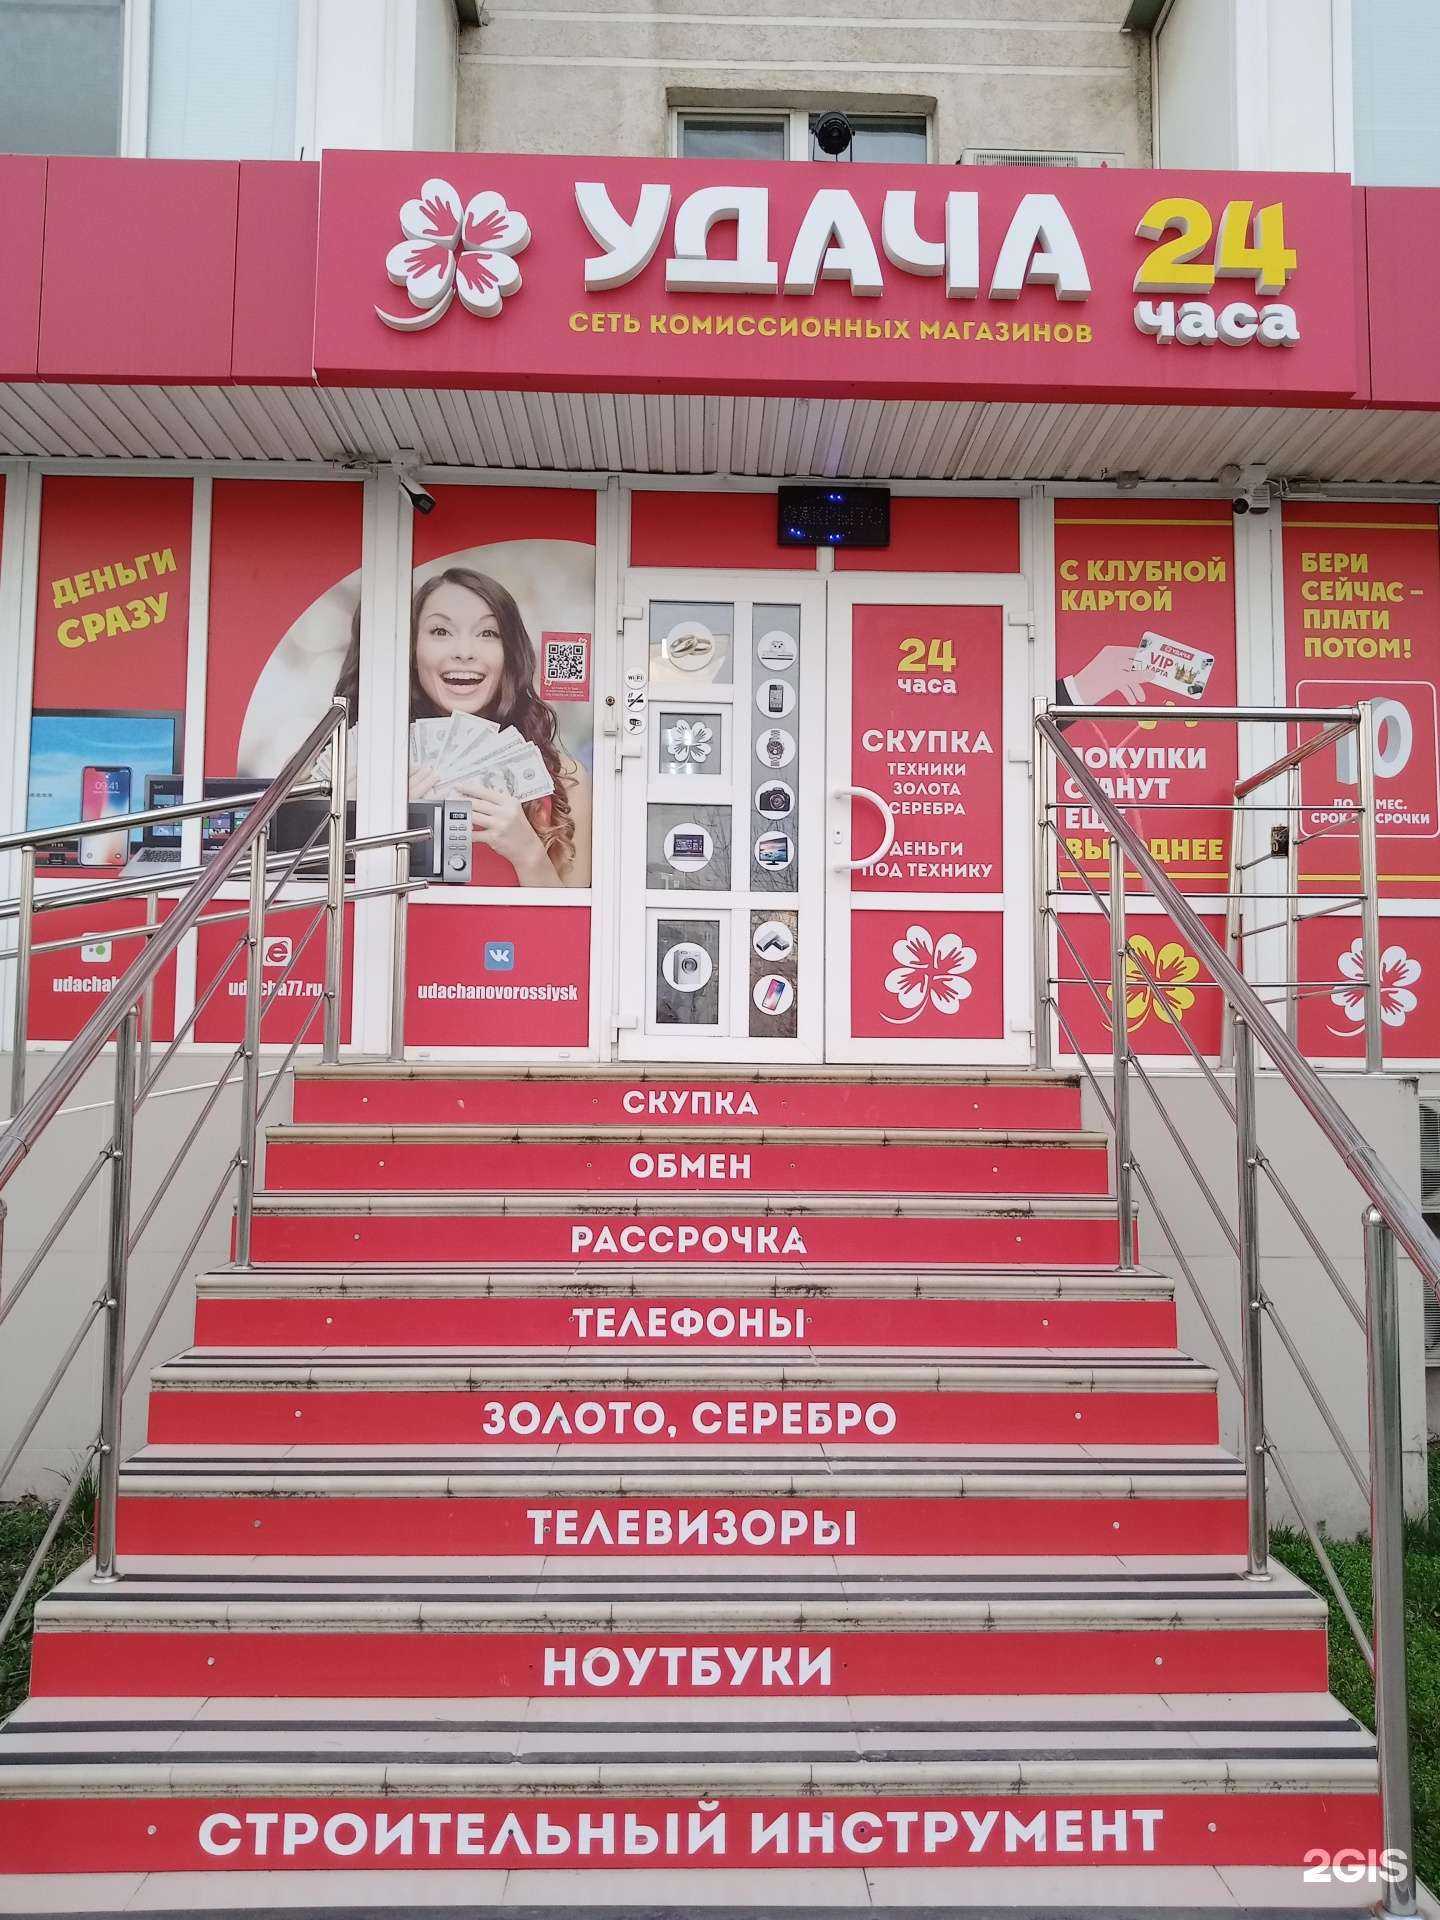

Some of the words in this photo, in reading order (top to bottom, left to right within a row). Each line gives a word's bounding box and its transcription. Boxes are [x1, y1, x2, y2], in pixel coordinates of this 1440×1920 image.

[575, 182, 1093, 299] УДАЧА
[1133, 198, 1298, 298] 24
[569, 311, 641, 334] СЕТЬ
[650, 314, 911, 340] КОМИССИОННЫХ
[919, 320, 1094, 344] МАГАЗИНОВ
[1134, 301, 1302, 347] часа
[1061, 560, 1080, 581] С
[1088, 555, 1227, 582] КЛУБНОЙ
[1302, 552, 1368, 574] БЕРИ
[52, 547, 178, 609] ДЕНЬГИ
[1302, 576, 1405, 604] СЕЙЧАС
[1062, 588, 1174, 613] КАРТОЙ
[56, 590, 170, 649] СРАЗУ
[1304, 609, 1391, 631] ПЛАТИ
[898, 637, 958, 674] 24
[1150, 651, 1174, 670] VIP
[1305, 637, 1413, 660] ПОТОМ!
[898, 678, 958, 695] часа
[862, 729, 995, 754] СКУПКА
[888, 763, 967, 776] ТЕХНИКИ
[894, 782, 962, 797] ЗОЛОТА
[1064, 777, 1170, 800] САНУТ
[889, 802, 966, 816] СЕРЕБРА
[1375, 799, 1408, 810] МЕС.
[1066, 808, 1126, 833] ЕЩ
[890, 841, 963, 857] ДЕНЬГИ
[1066, 838, 1224, 863] ВЫДНЕЕ
[862, 863, 902, 878] ПОД
[907, 863, 993, 878] ТЕХНИКУ
[228, 979, 323, 997] udcha77.ru
[418, 983, 578, 1001] udachanovorossiysk
[623, 1091, 759, 1116] СКУПКА
[630, 1153, 752, 1180] ОБМЕН
[572, 1226, 807, 1255] РАССРОЧКА
[573, 1308, 805, 1339] ТЕЛЕФОНЫ
[483, 1402, 677, 1439] ЗОЛОТО,
[693, 1402, 898, 1436] СЕРЕБРО
[527, 1510, 857, 1547] ТЕЛЕВИЗОРЫ
[544, 1647, 832, 1688] НОУТБУКИ
[198, 1797, 728, 1858] СТРОИТЕЛЬНЫЙ
[751, 1809, 1165, 1855] ИНСТРУМЕНТ
